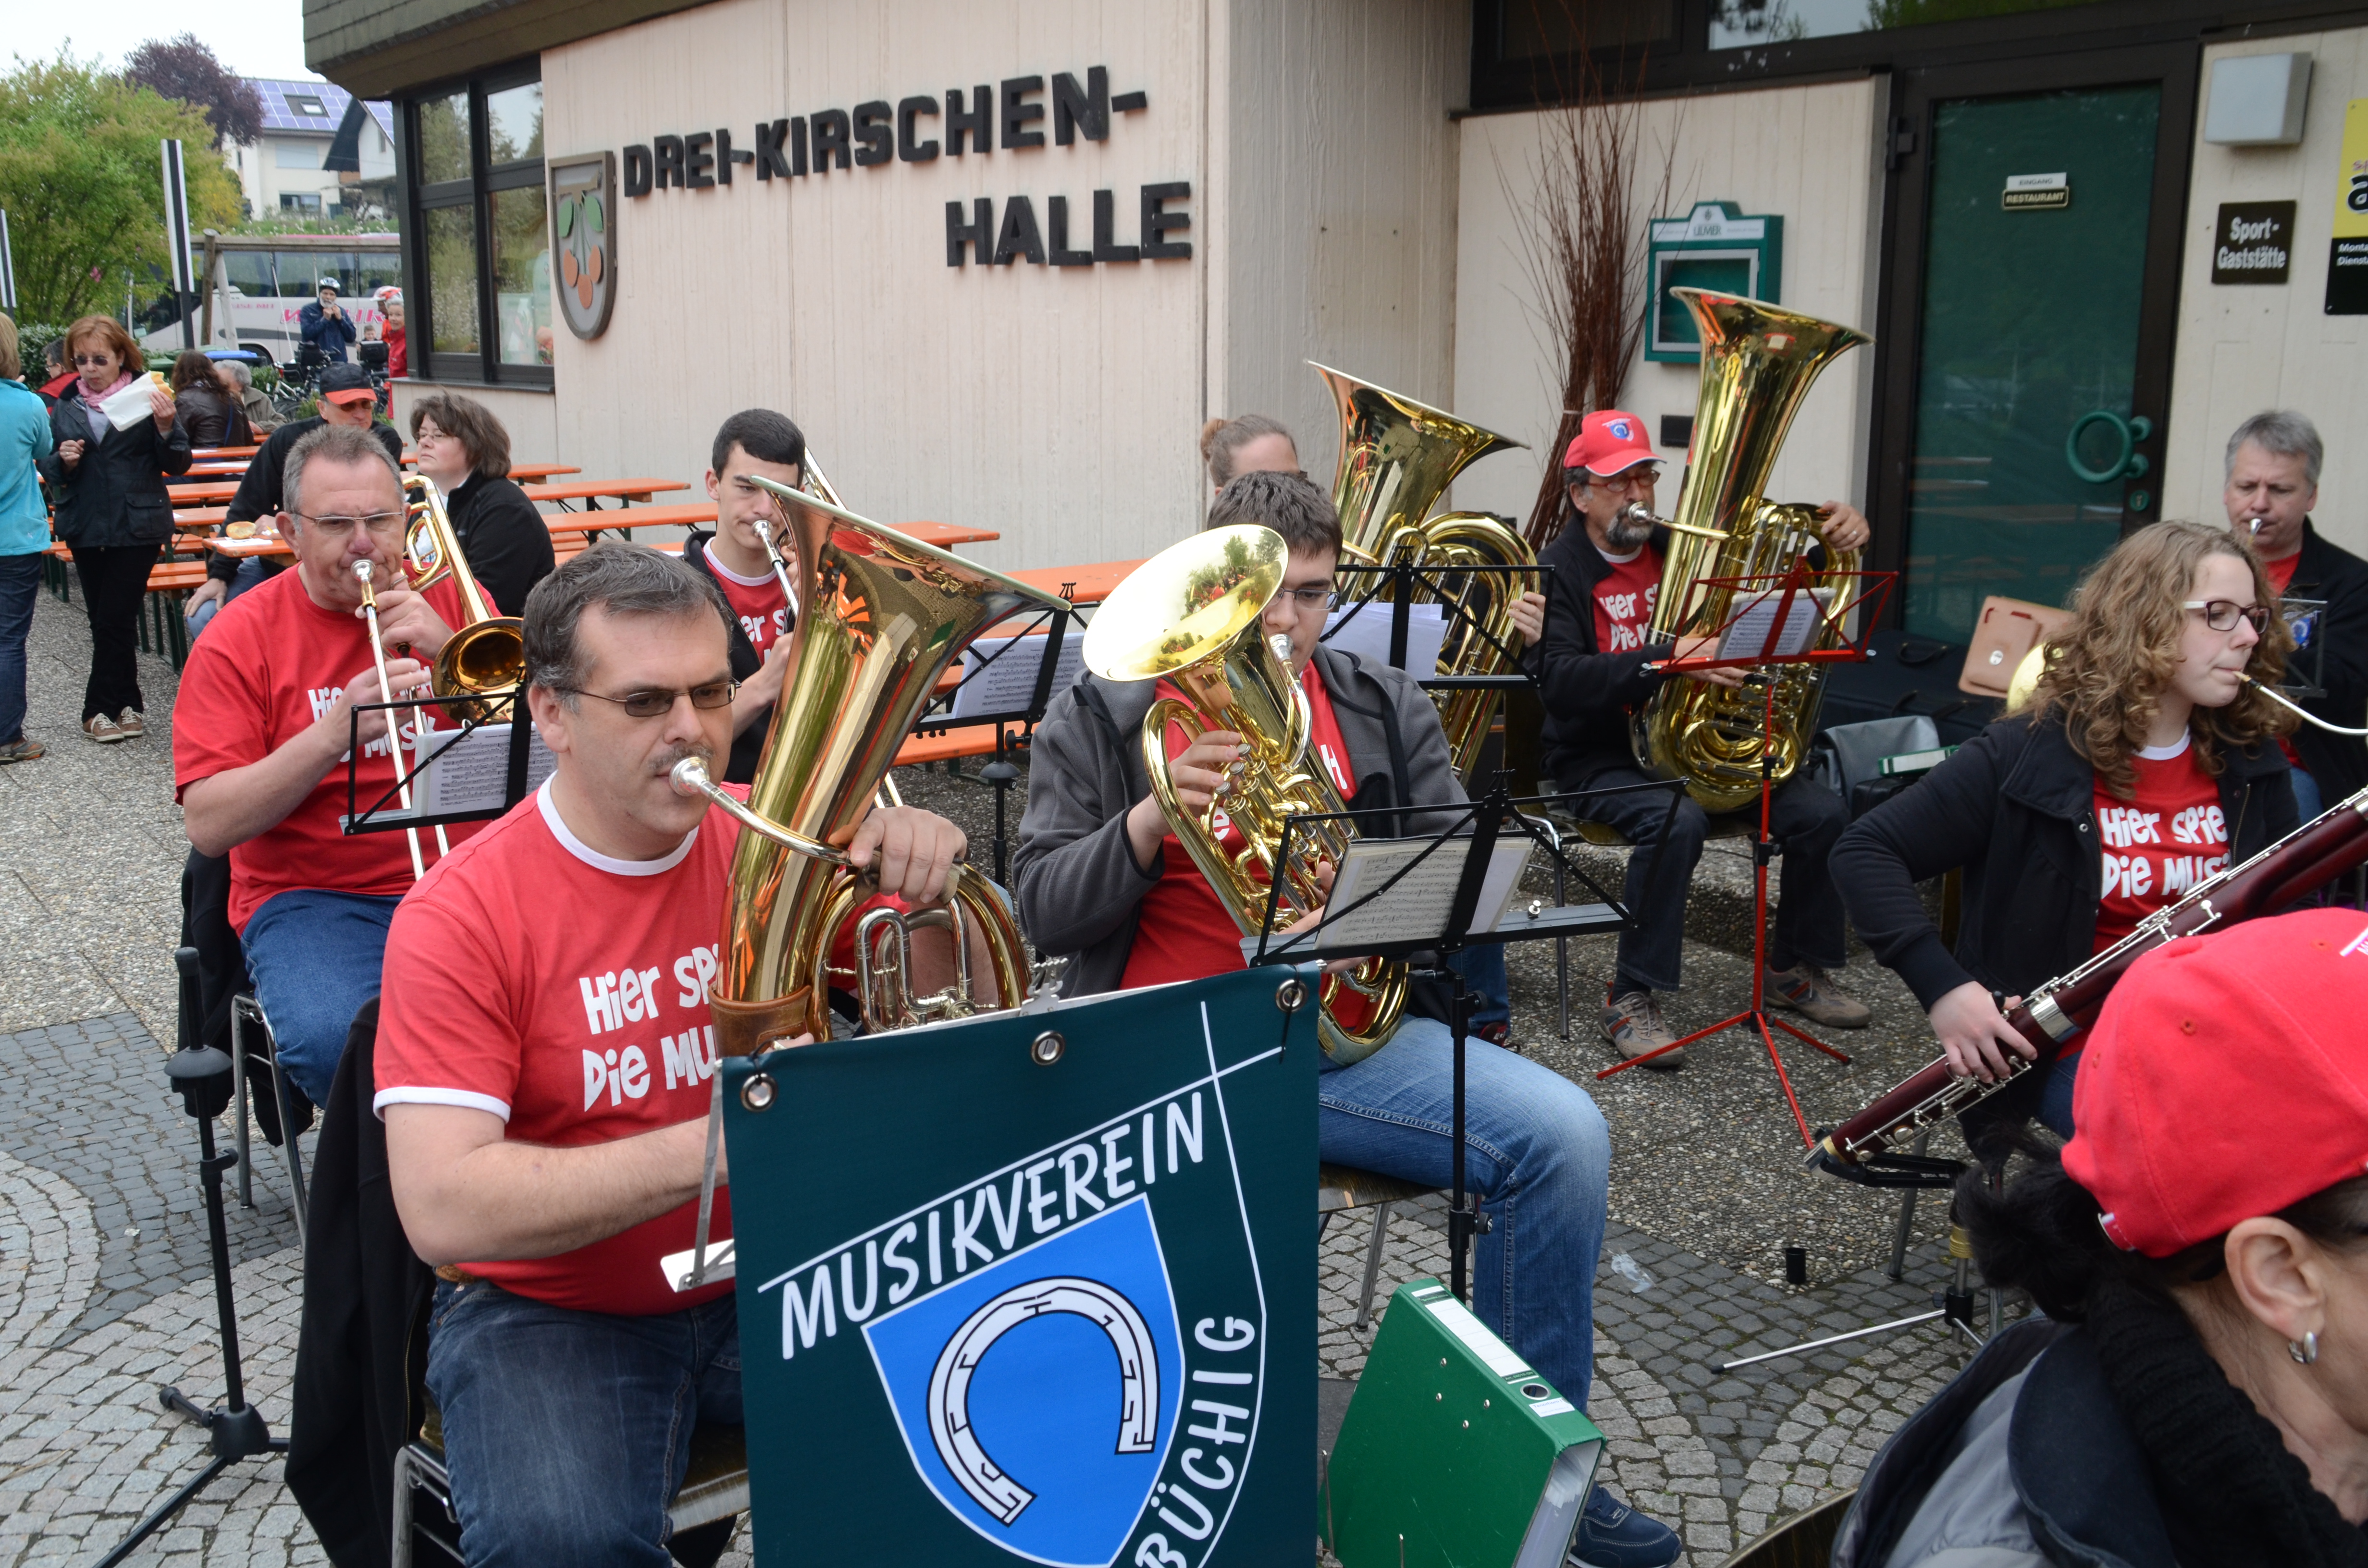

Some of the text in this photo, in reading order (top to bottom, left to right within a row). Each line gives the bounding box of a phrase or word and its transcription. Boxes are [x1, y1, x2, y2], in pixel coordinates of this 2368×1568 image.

[623, 65, 1147, 197] DREI-KIRSCHEN-
[2006, 192, 2065, 204] RESTAURANT
[945, 181, 1193, 267] HALLE
[1693, 225, 1722, 236] ULMER
[2229, 216, 2280, 245] Sport-
[2217, 245, 2286, 270] Gaststätte
[740, 615, 765, 642] er
[1610, 623, 1638, 652] Die
[2099, 807, 2161, 847] Hier
[2101, 853, 2153, 899] Die
[579, 966, 661, 1035] Hier
[582, 1045, 651, 1112] Die
[782, 1091, 1203, 1360] MUSIKVEREIN
[1135, 1315, 1256, 1568] BÜCHIG
